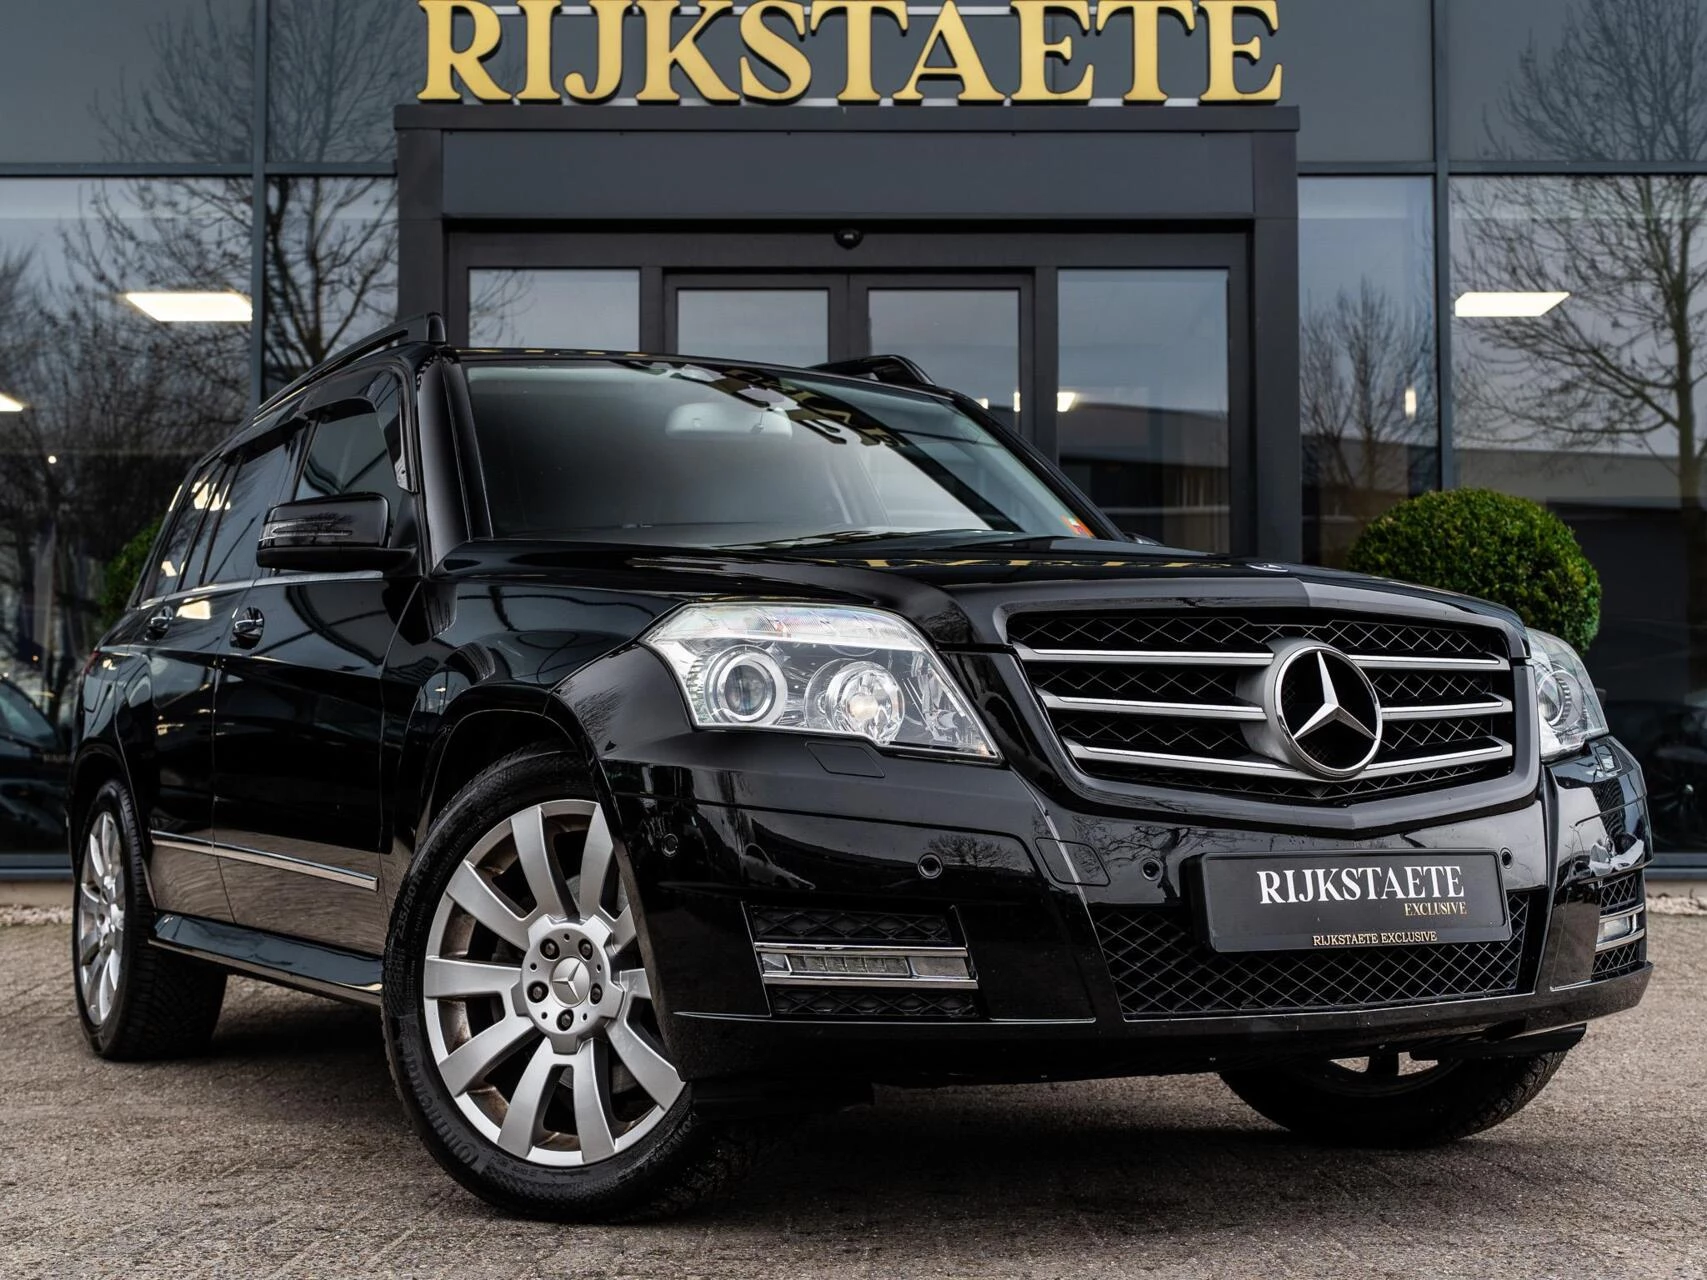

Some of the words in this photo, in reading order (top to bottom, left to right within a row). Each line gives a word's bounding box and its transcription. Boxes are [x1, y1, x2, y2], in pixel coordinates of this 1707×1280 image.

[417, 0, 1284, 105] RIJKSTAETE
[1257, 866, 1465, 904] RIJKSTAETE
[1404, 901, 1467, 917] EXCLUSIVE
[1312, 932, 1379, 947] RIJKSTAETE
[1381, 931, 1438, 944] EXCLUSIVE
